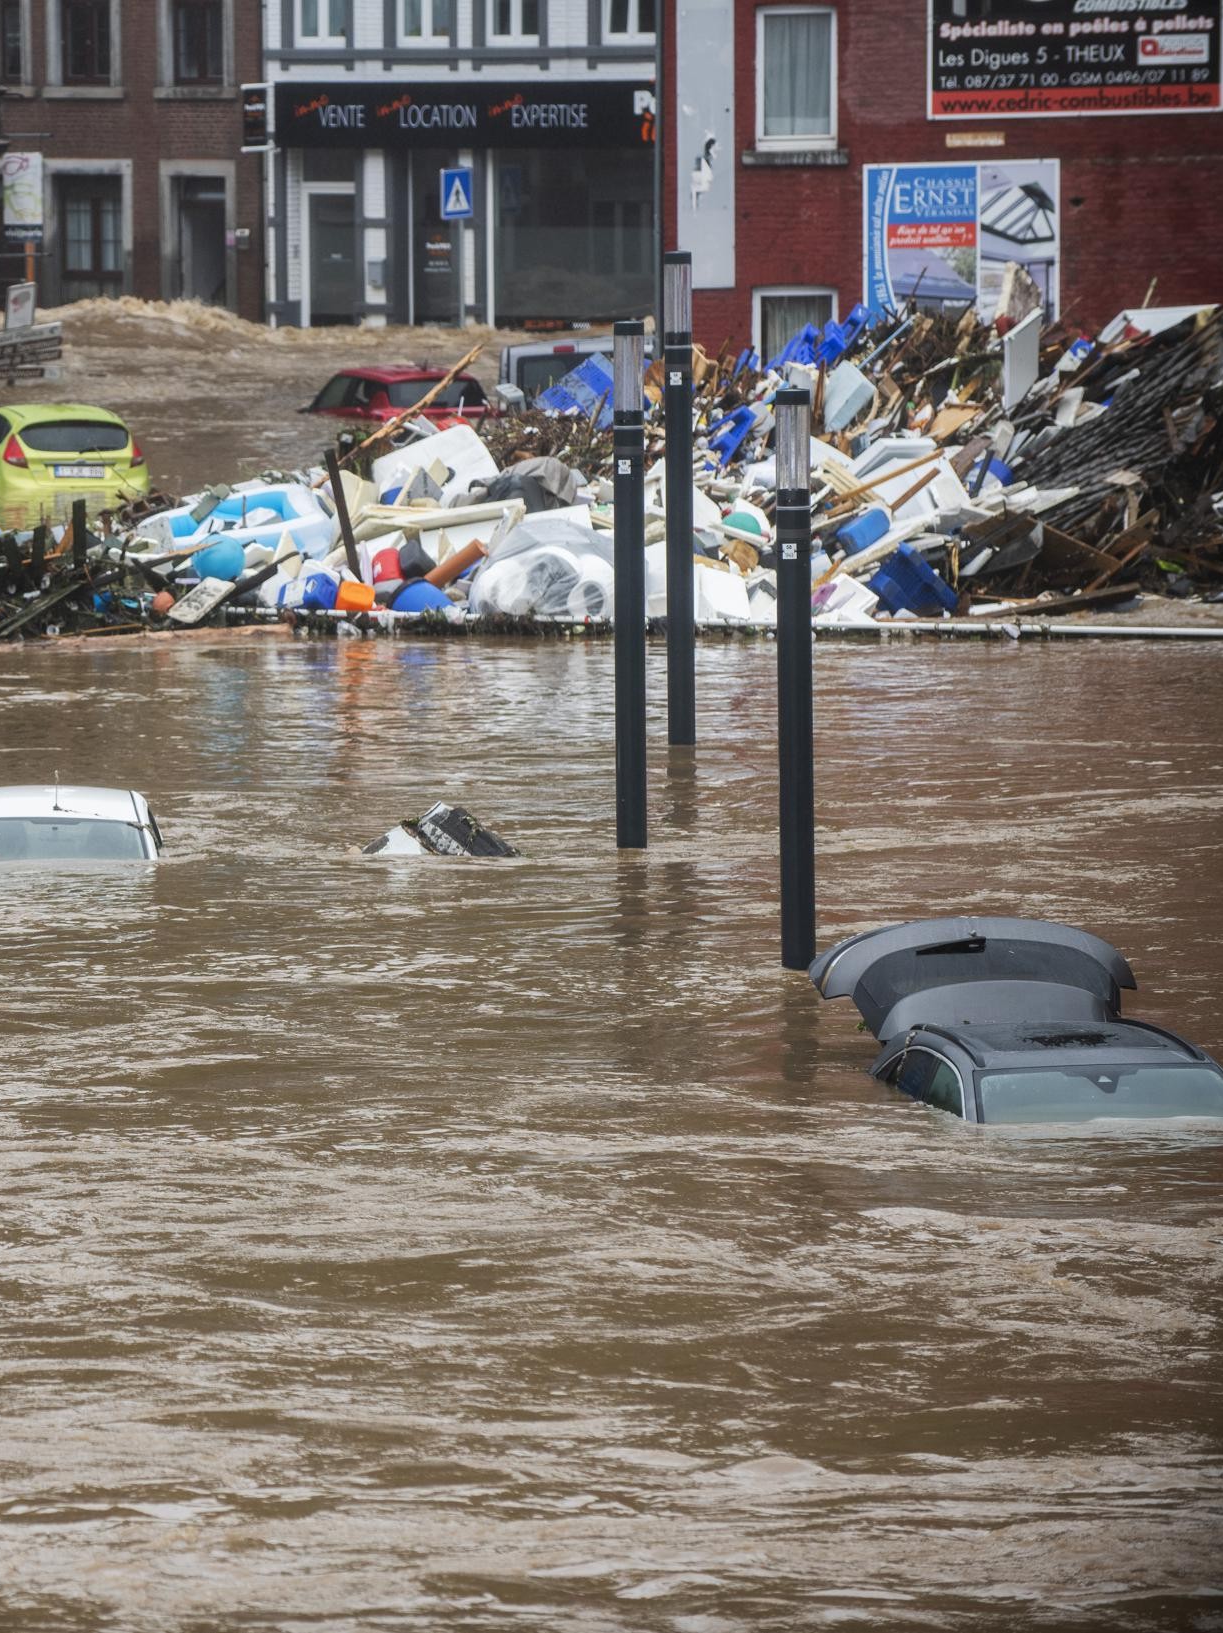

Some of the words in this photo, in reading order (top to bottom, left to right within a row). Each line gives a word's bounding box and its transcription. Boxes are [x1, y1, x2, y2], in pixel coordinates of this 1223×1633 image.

[939, 20, 1037, 41] Spécialiste
[1041, 22, 1064, 35] en
[1069, 17, 1129, 38] poêles
[1134, 16, 1147, 32] à
[1152, 14, 1214, 34] pellets
[939, 49, 965, 67] Les
[970, 47, 1030, 70] Digues
[1035, 46, 1048, 64] 5
[1065, 44, 1126, 63] THEUX
[964, 74, 1015, 88] 087/37
[1019, 73, 1036, 87] 71
[1040, 72, 1059, 86] 00
[1069, 71, 1103, 86] GSM
[1105, 70, 1165, 84] 0496/07
[1171, 69, 1186, 82] 11
[1191, 68, 1210, 82] 89
[940, 87, 1212, 112] www.cedric-combustibles.be
[319, 104, 365, 128] VENTE
[399, 104, 477, 128] LOCATION
[511, 103, 588, 128] EXPERTISE
[914, 176, 975, 189] CHASSIS
[894, 184, 975, 214] ERNST
